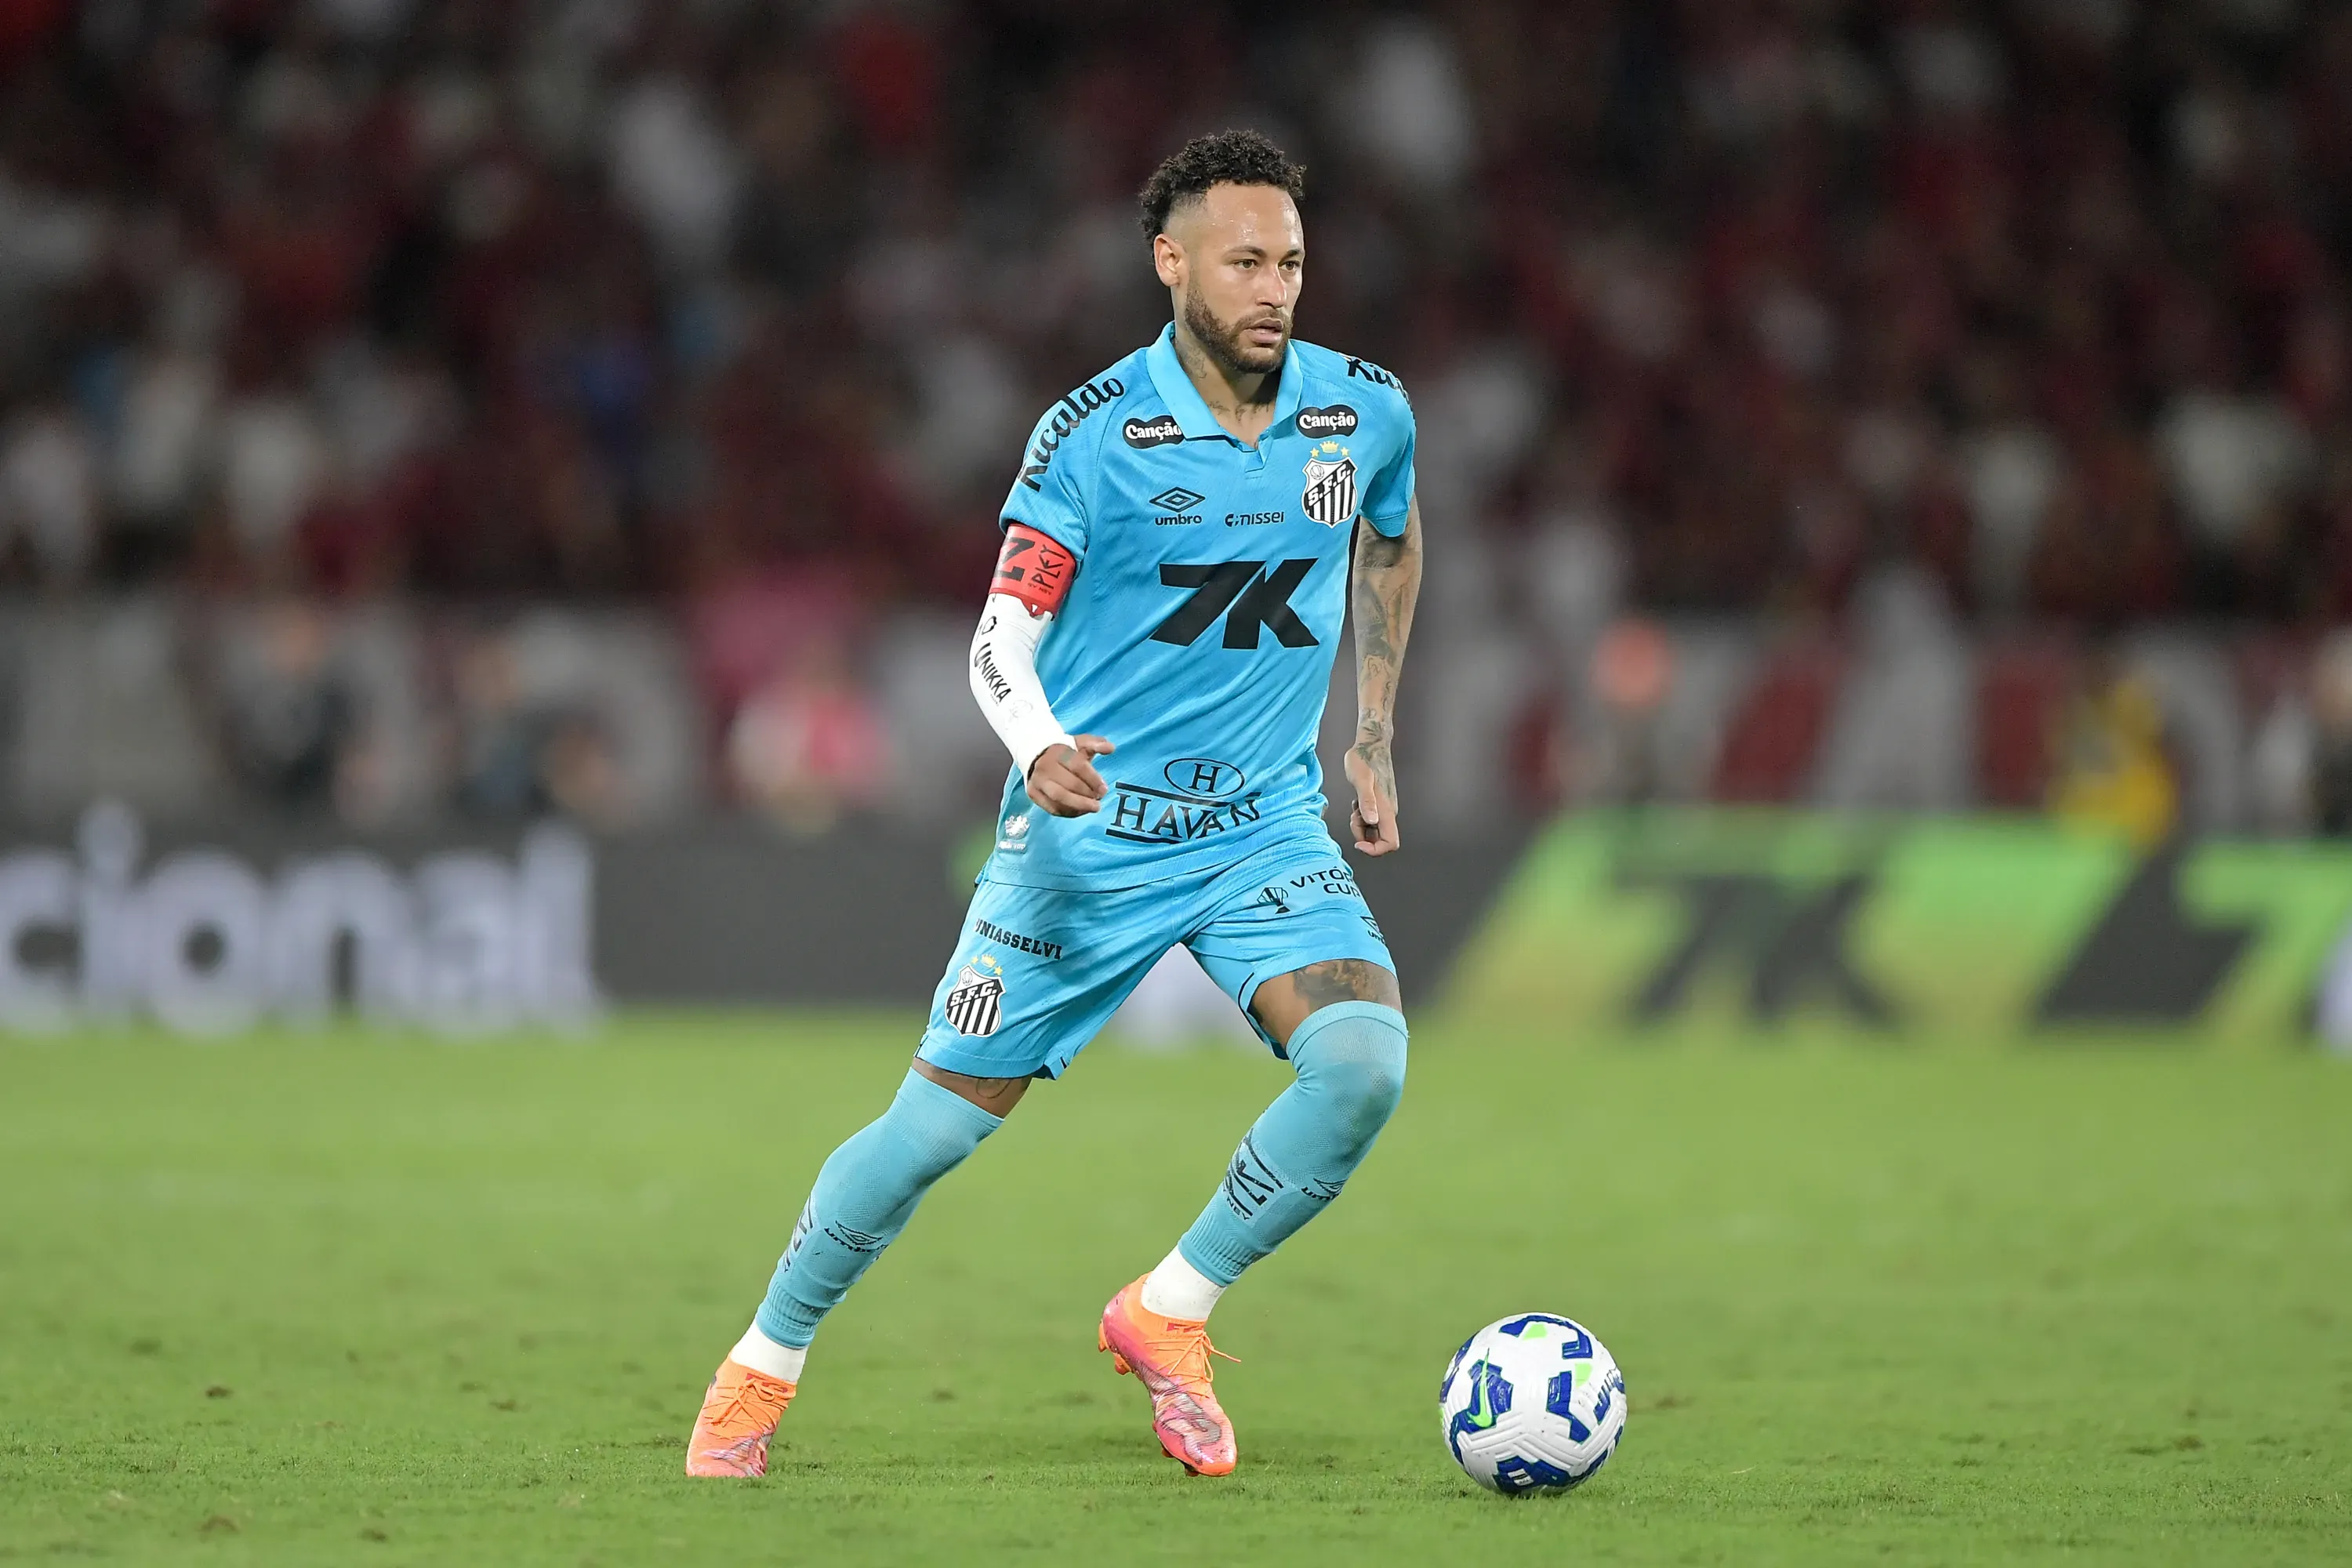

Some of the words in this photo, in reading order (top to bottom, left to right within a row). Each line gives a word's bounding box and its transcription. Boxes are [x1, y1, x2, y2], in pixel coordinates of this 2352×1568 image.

[1299, 411, 1356, 431] Canção
[1155, 514, 1202, 525] umbro
[1149, 557, 1319, 650] 7K
[1187, 763, 1222, 793] H
[1110, 793, 1261, 840] HAVAN
